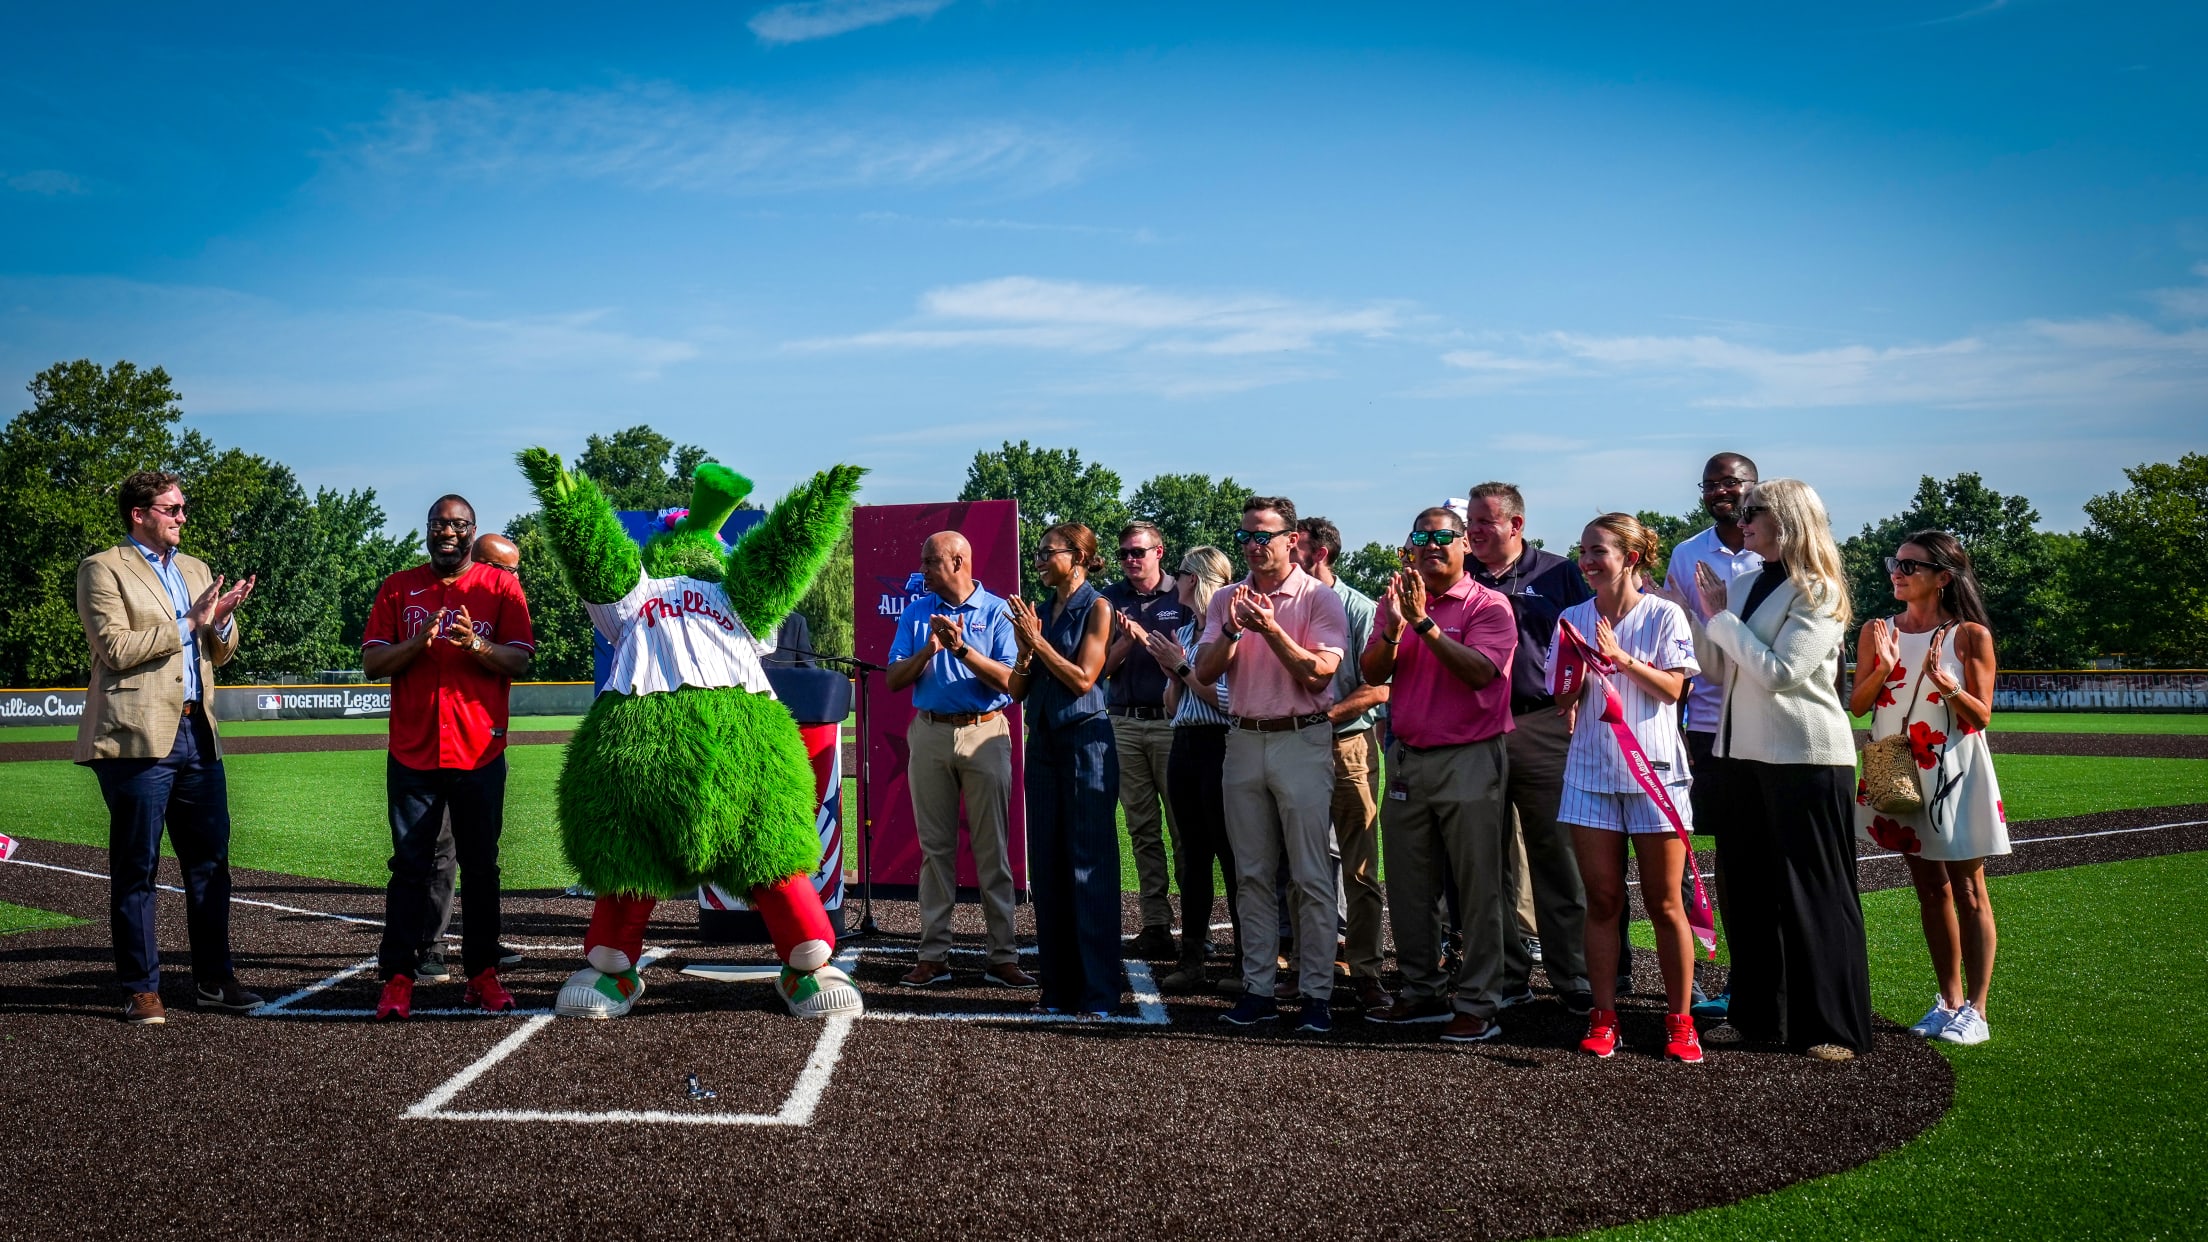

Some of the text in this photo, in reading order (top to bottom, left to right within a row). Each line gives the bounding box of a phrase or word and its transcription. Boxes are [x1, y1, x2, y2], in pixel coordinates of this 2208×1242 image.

[639, 590, 734, 631] Phillies
[1995, 675, 2111, 690] LADELPHIA
[283, 690, 391, 713] TOGETHER Legac
[1993, 690, 2047, 706] RBAN
[2047, 690, 2119, 707] YOUTH
